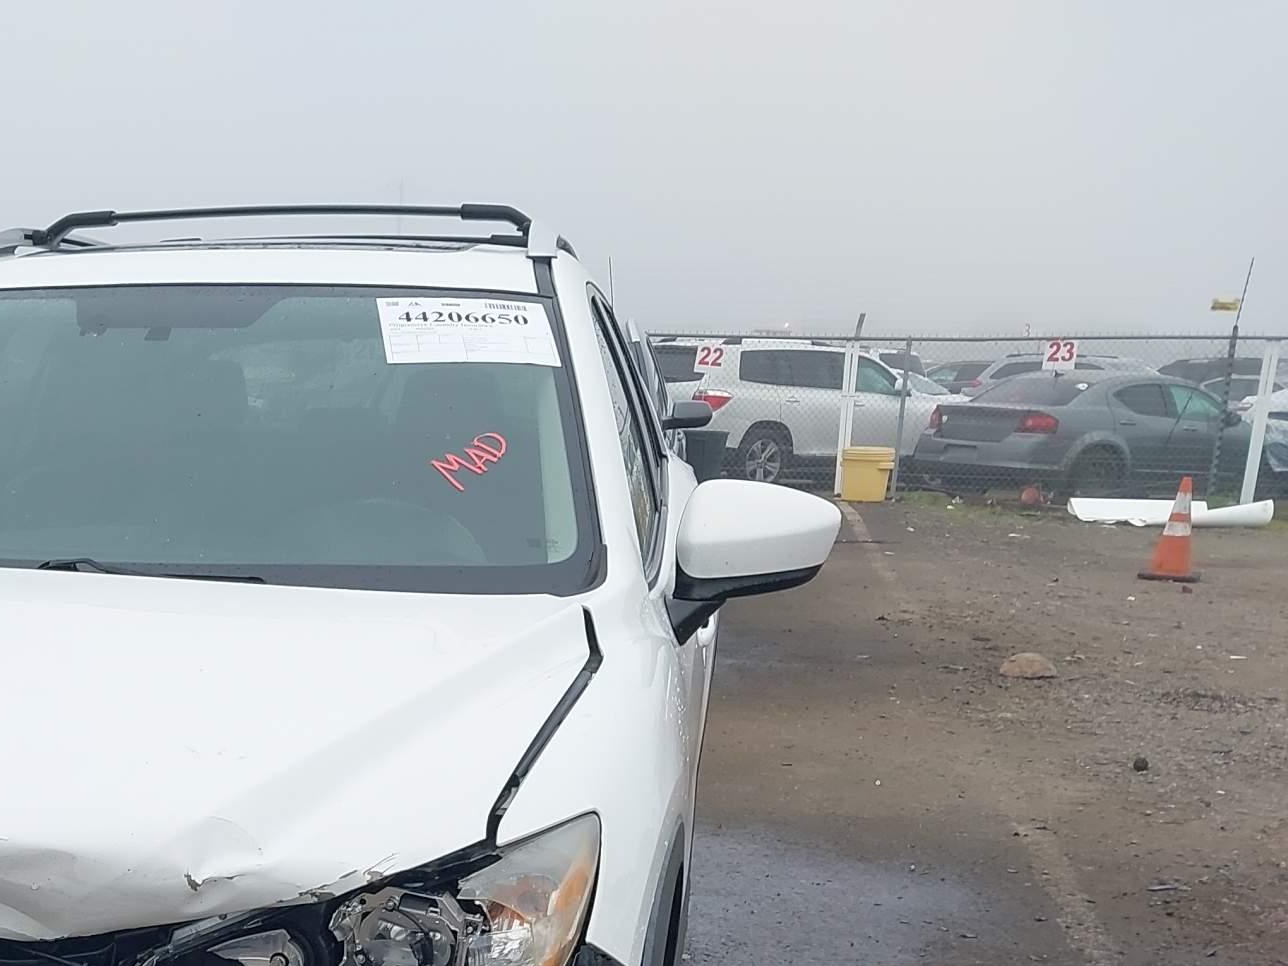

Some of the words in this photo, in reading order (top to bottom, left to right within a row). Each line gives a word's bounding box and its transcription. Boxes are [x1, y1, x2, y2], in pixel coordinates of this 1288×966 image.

[398, 310, 529, 326] 44206650
[697, 347, 724, 367] 22
[1047, 341, 1075, 362] 23
[431, 432, 508, 491] MAD
